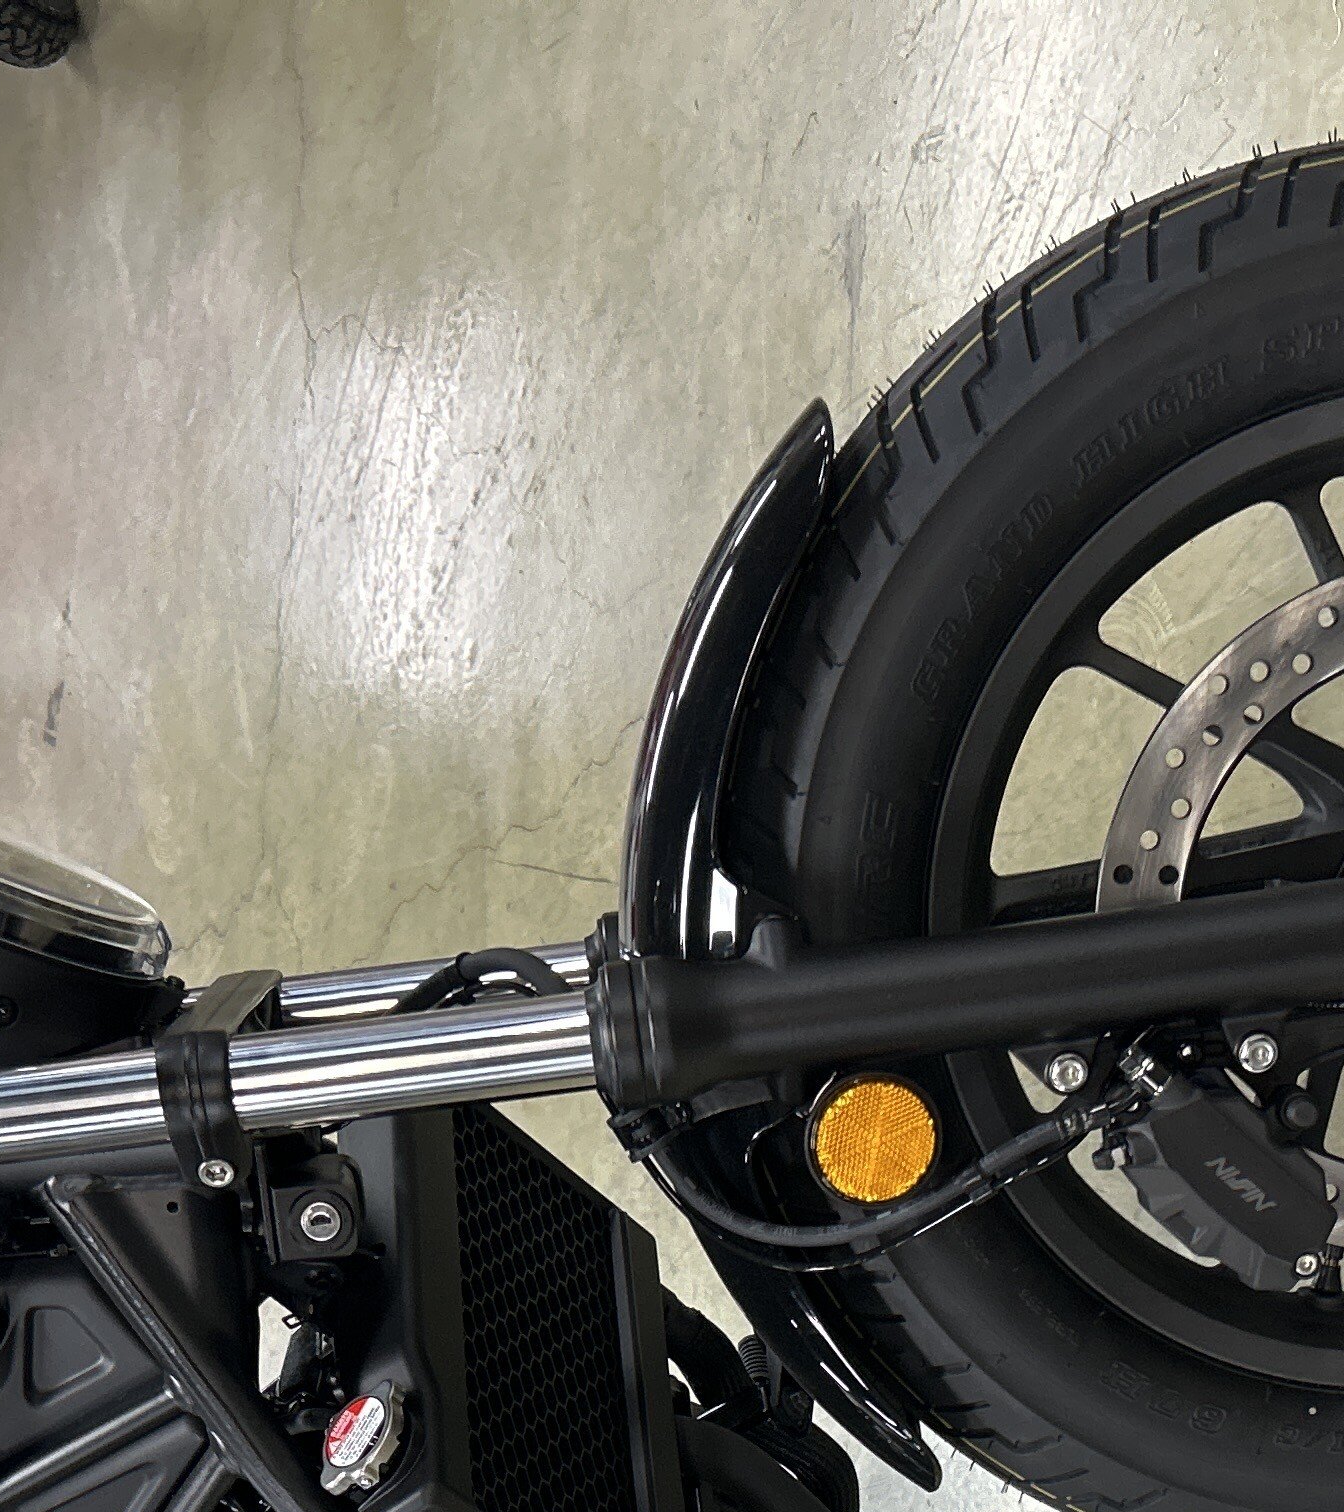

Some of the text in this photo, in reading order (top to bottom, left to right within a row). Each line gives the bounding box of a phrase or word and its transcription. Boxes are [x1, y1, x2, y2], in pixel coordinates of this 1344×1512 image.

[906, 491, 1060, 706] GRAND
[1070, 350, 1234, 484] HIGH
[1098, 1356, 1230, 1435] 67H
